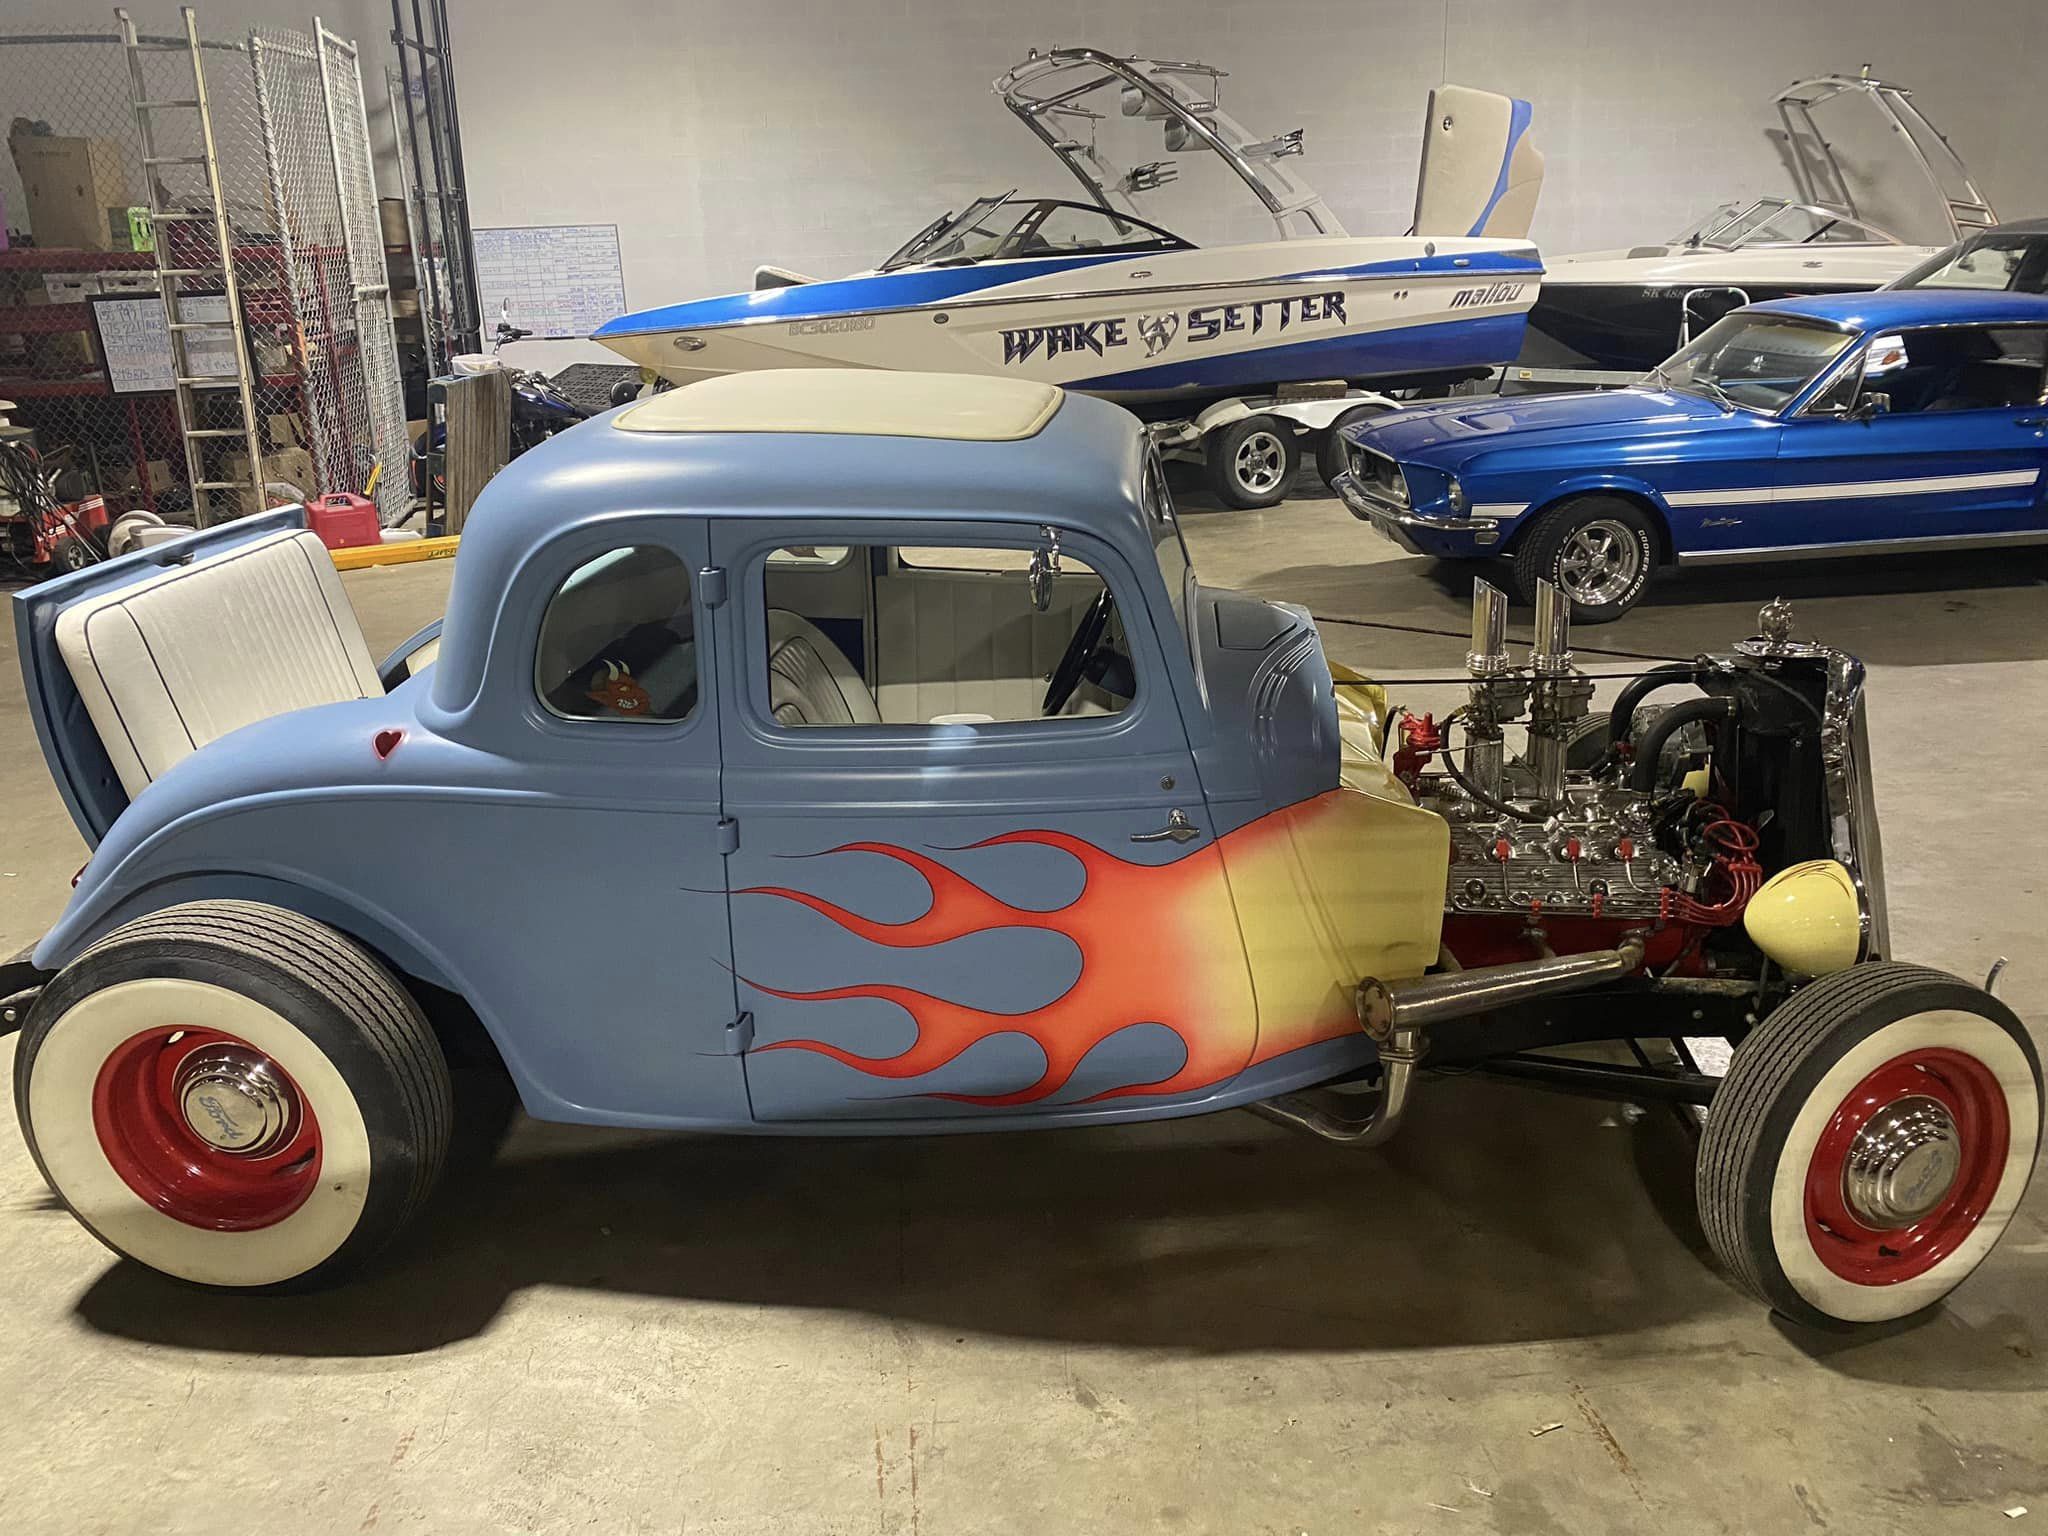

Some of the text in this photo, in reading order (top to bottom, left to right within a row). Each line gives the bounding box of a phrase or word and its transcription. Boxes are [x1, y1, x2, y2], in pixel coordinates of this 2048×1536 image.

[1449, 281, 1525, 308] malibu
[999, 290, 1347, 365] WAKE SETTER
[1617, 529, 1650, 606] COOPER COBRA
[199, 1096, 244, 1139] Ford
